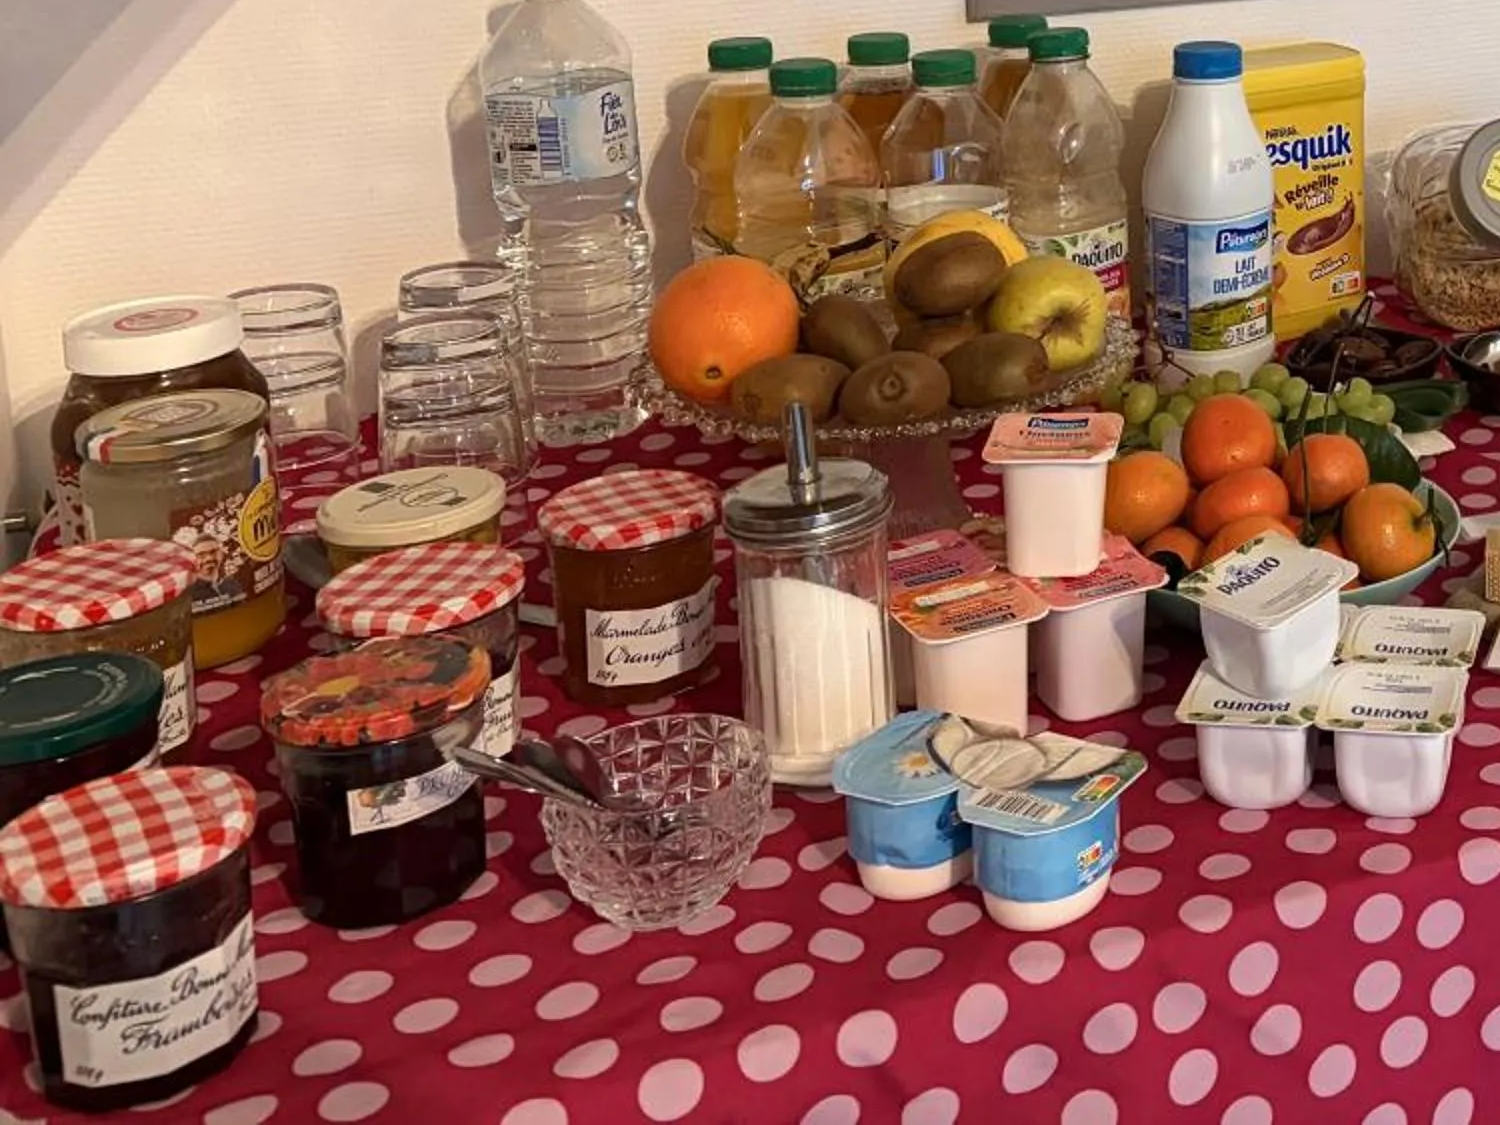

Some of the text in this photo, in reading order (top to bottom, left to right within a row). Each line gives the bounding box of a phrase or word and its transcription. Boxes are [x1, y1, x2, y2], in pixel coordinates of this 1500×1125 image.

[1265, 123, 1351, 170] esquik
[1284, 174, 1339, 205] Réveille
[1235, 255, 1256, 274] LAIT
[1216, 555, 1281, 596] PAQUITO
[1374, 641, 1449, 657] PAQUITO
[1212, 698, 1292, 713] PAQUITO
[1350, 704, 1429, 721] PAQUITO
[69, 992, 170, 1031] Confiture
